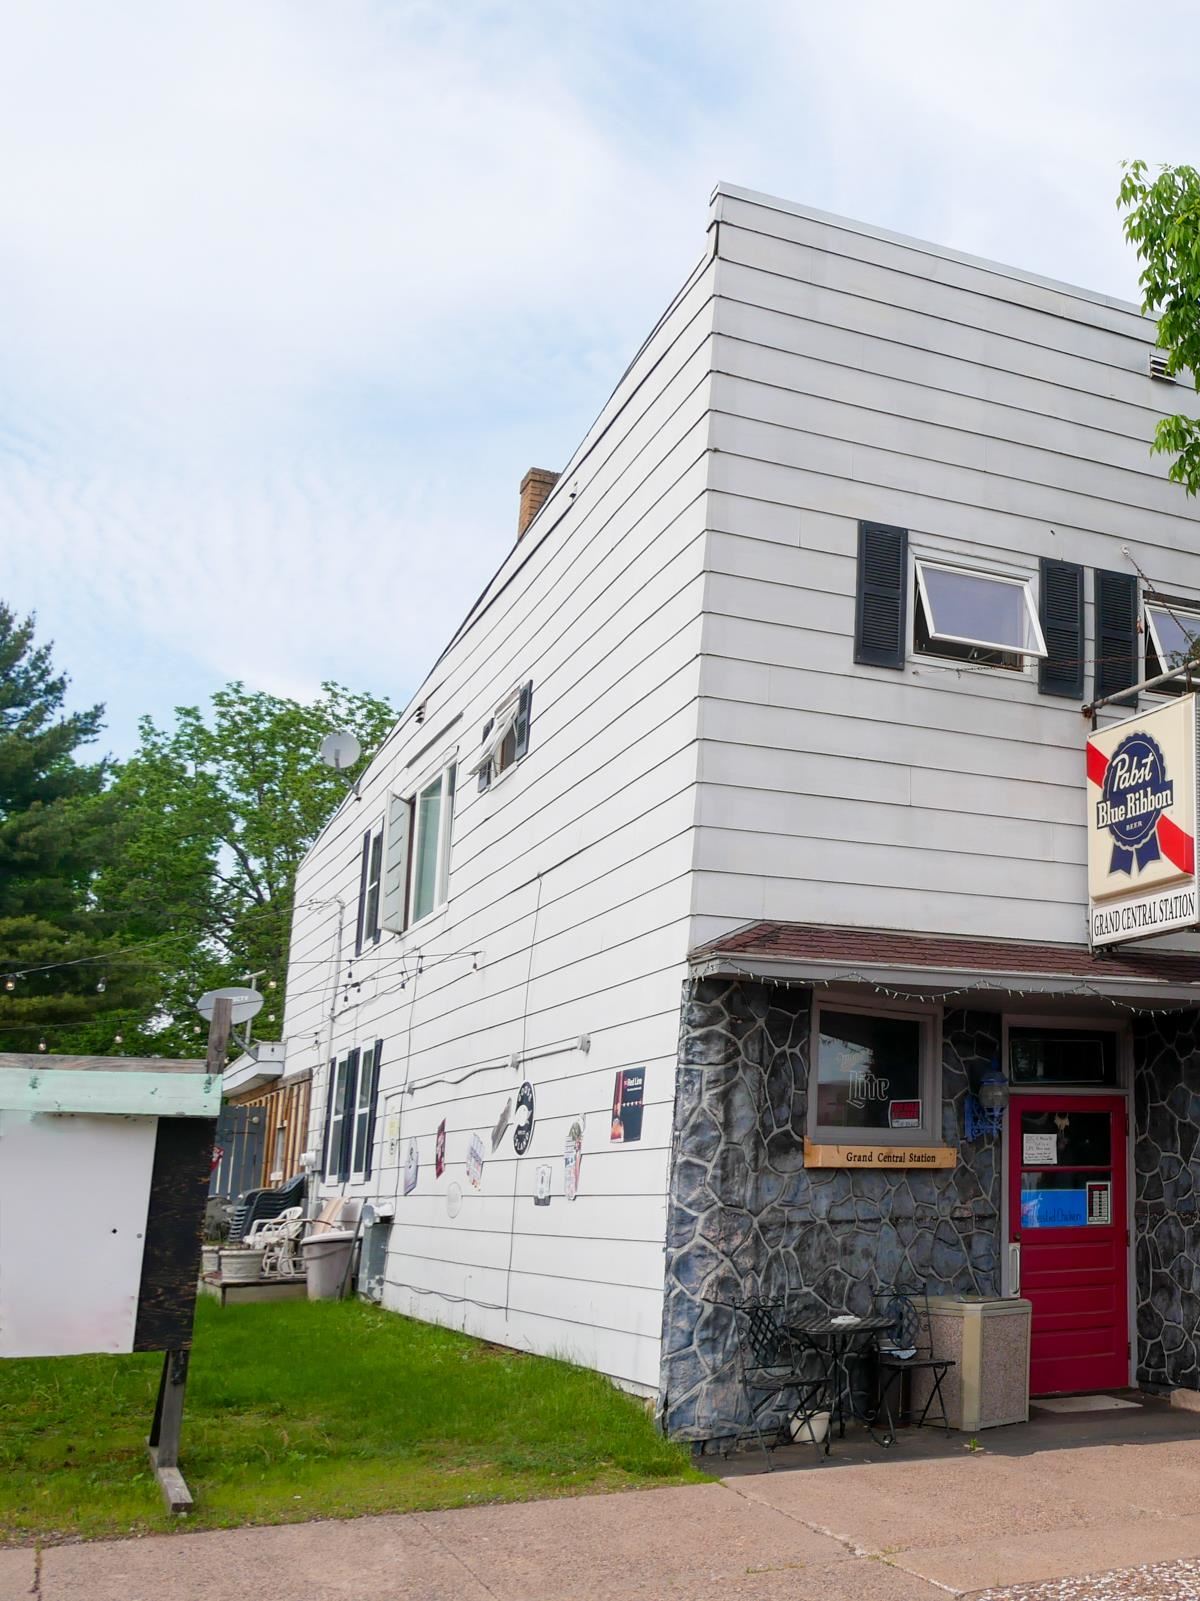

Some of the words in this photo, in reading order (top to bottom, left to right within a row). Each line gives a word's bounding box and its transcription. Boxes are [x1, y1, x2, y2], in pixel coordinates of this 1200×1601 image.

[1112, 753, 1154, 792] Pabst
[1097, 800, 1126, 828] Blue
[1126, 787, 1172, 818] Ribbon
[1126, 821, 1142, 831] BEER
[1094, 911, 1120, 936] GRAND
[1122, 902, 1157, 930] CENTRAL
[1159, 892, 1195, 922] STATION
[846, 1071, 890, 1109] Lite
[846, 1152, 873, 1163] Grand
[877, 1152, 906, 1164] Central
[908, 1152, 937, 1163] Station
